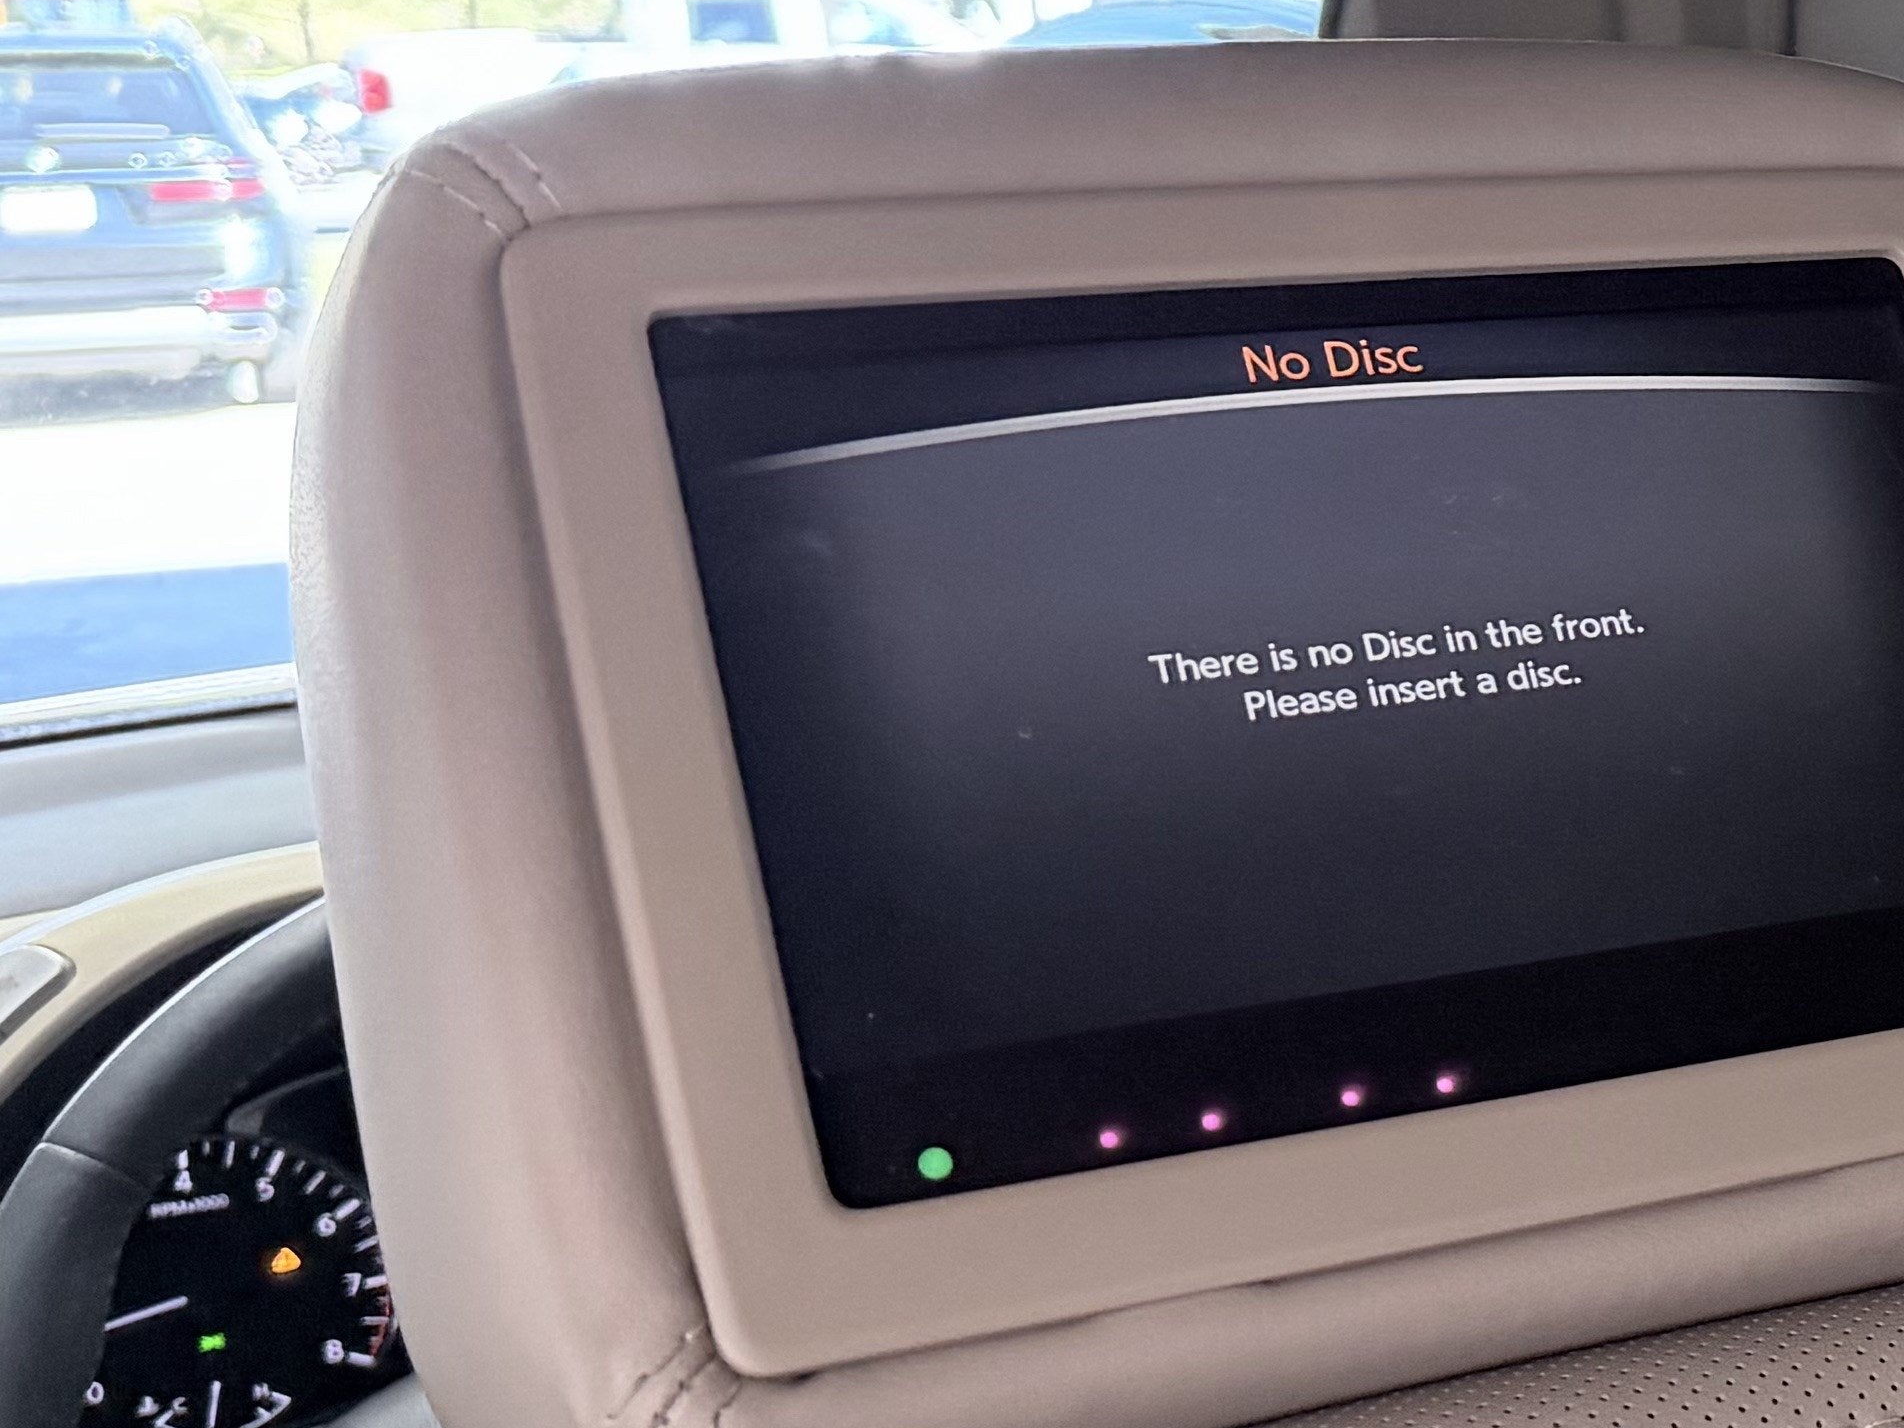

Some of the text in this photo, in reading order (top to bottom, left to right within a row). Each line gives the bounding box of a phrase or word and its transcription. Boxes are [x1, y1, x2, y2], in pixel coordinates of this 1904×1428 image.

[1242, 335, 1424, 383] No Disc
[1146, 607, 1646, 685] There is no Disc in the front.
[1243, 659, 1583, 723] Please insert a disc.
[255, 1177, 275, 1201] 5
[315, 1213, 336, 1237] 6
[344, 1272, 361, 1298] 7
[324, 1339, 344, 1365] 8
